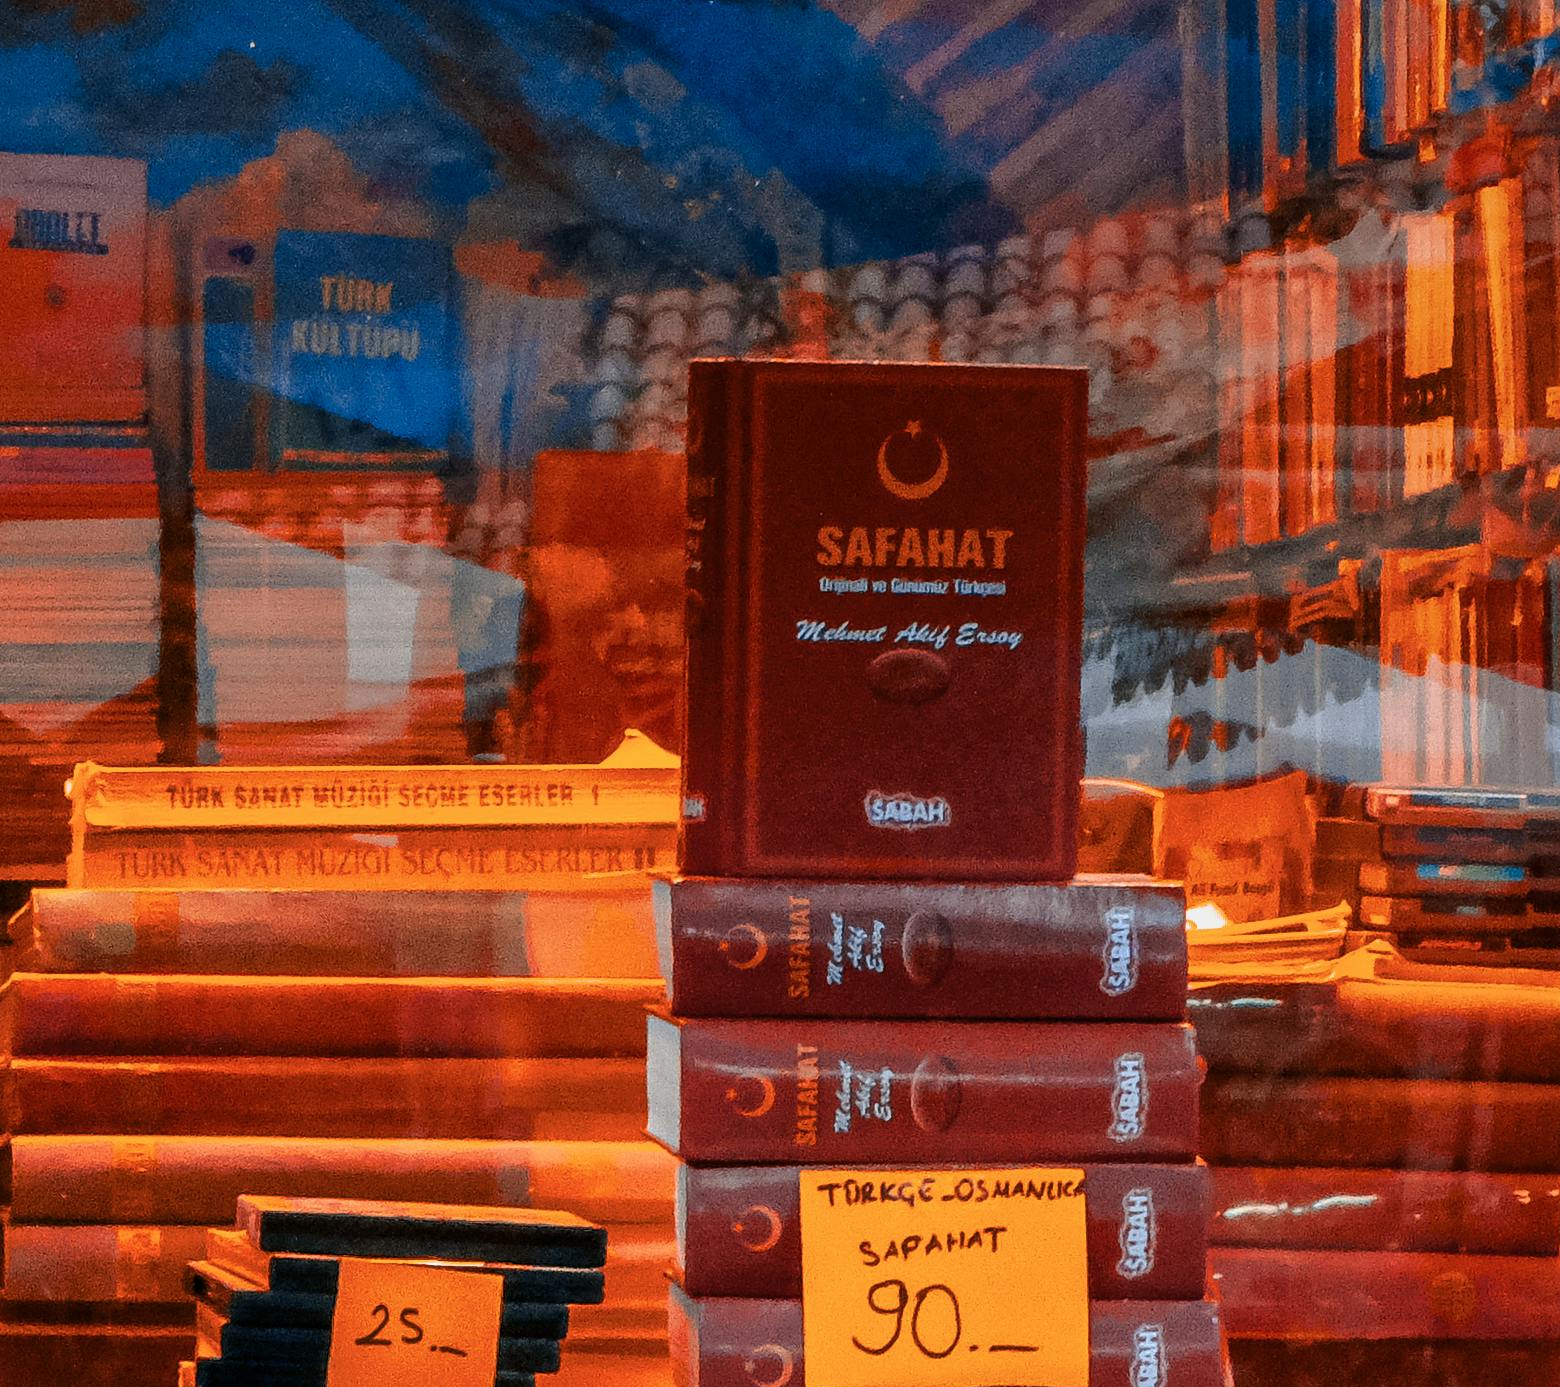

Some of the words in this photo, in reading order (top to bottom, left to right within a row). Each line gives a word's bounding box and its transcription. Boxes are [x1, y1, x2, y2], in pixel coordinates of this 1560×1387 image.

[816, 527, 1014, 569] SAFAHAT
[796, 619, 885, 643] Mehmet
[893, 621, 950, 649] Akif
[955, 621, 1022, 649] Ersoy
[167, 784, 224, 810] TÜRK
[870, 800, 945, 822] SABAH
[117, 846, 187, 880] TÜRK
[197, 849, 281, 879] SANAT
[503, 845, 625, 876] ESERLER
[788, 896, 811, 999] SAFAHAT
[1108, 909, 1131, 990] SABAH
[795, 1043, 819, 1146] SAFAHAT
[1120, 1058, 1142, 1137] SABAH
[1123, 1193, 1148, 1274] SABAH
